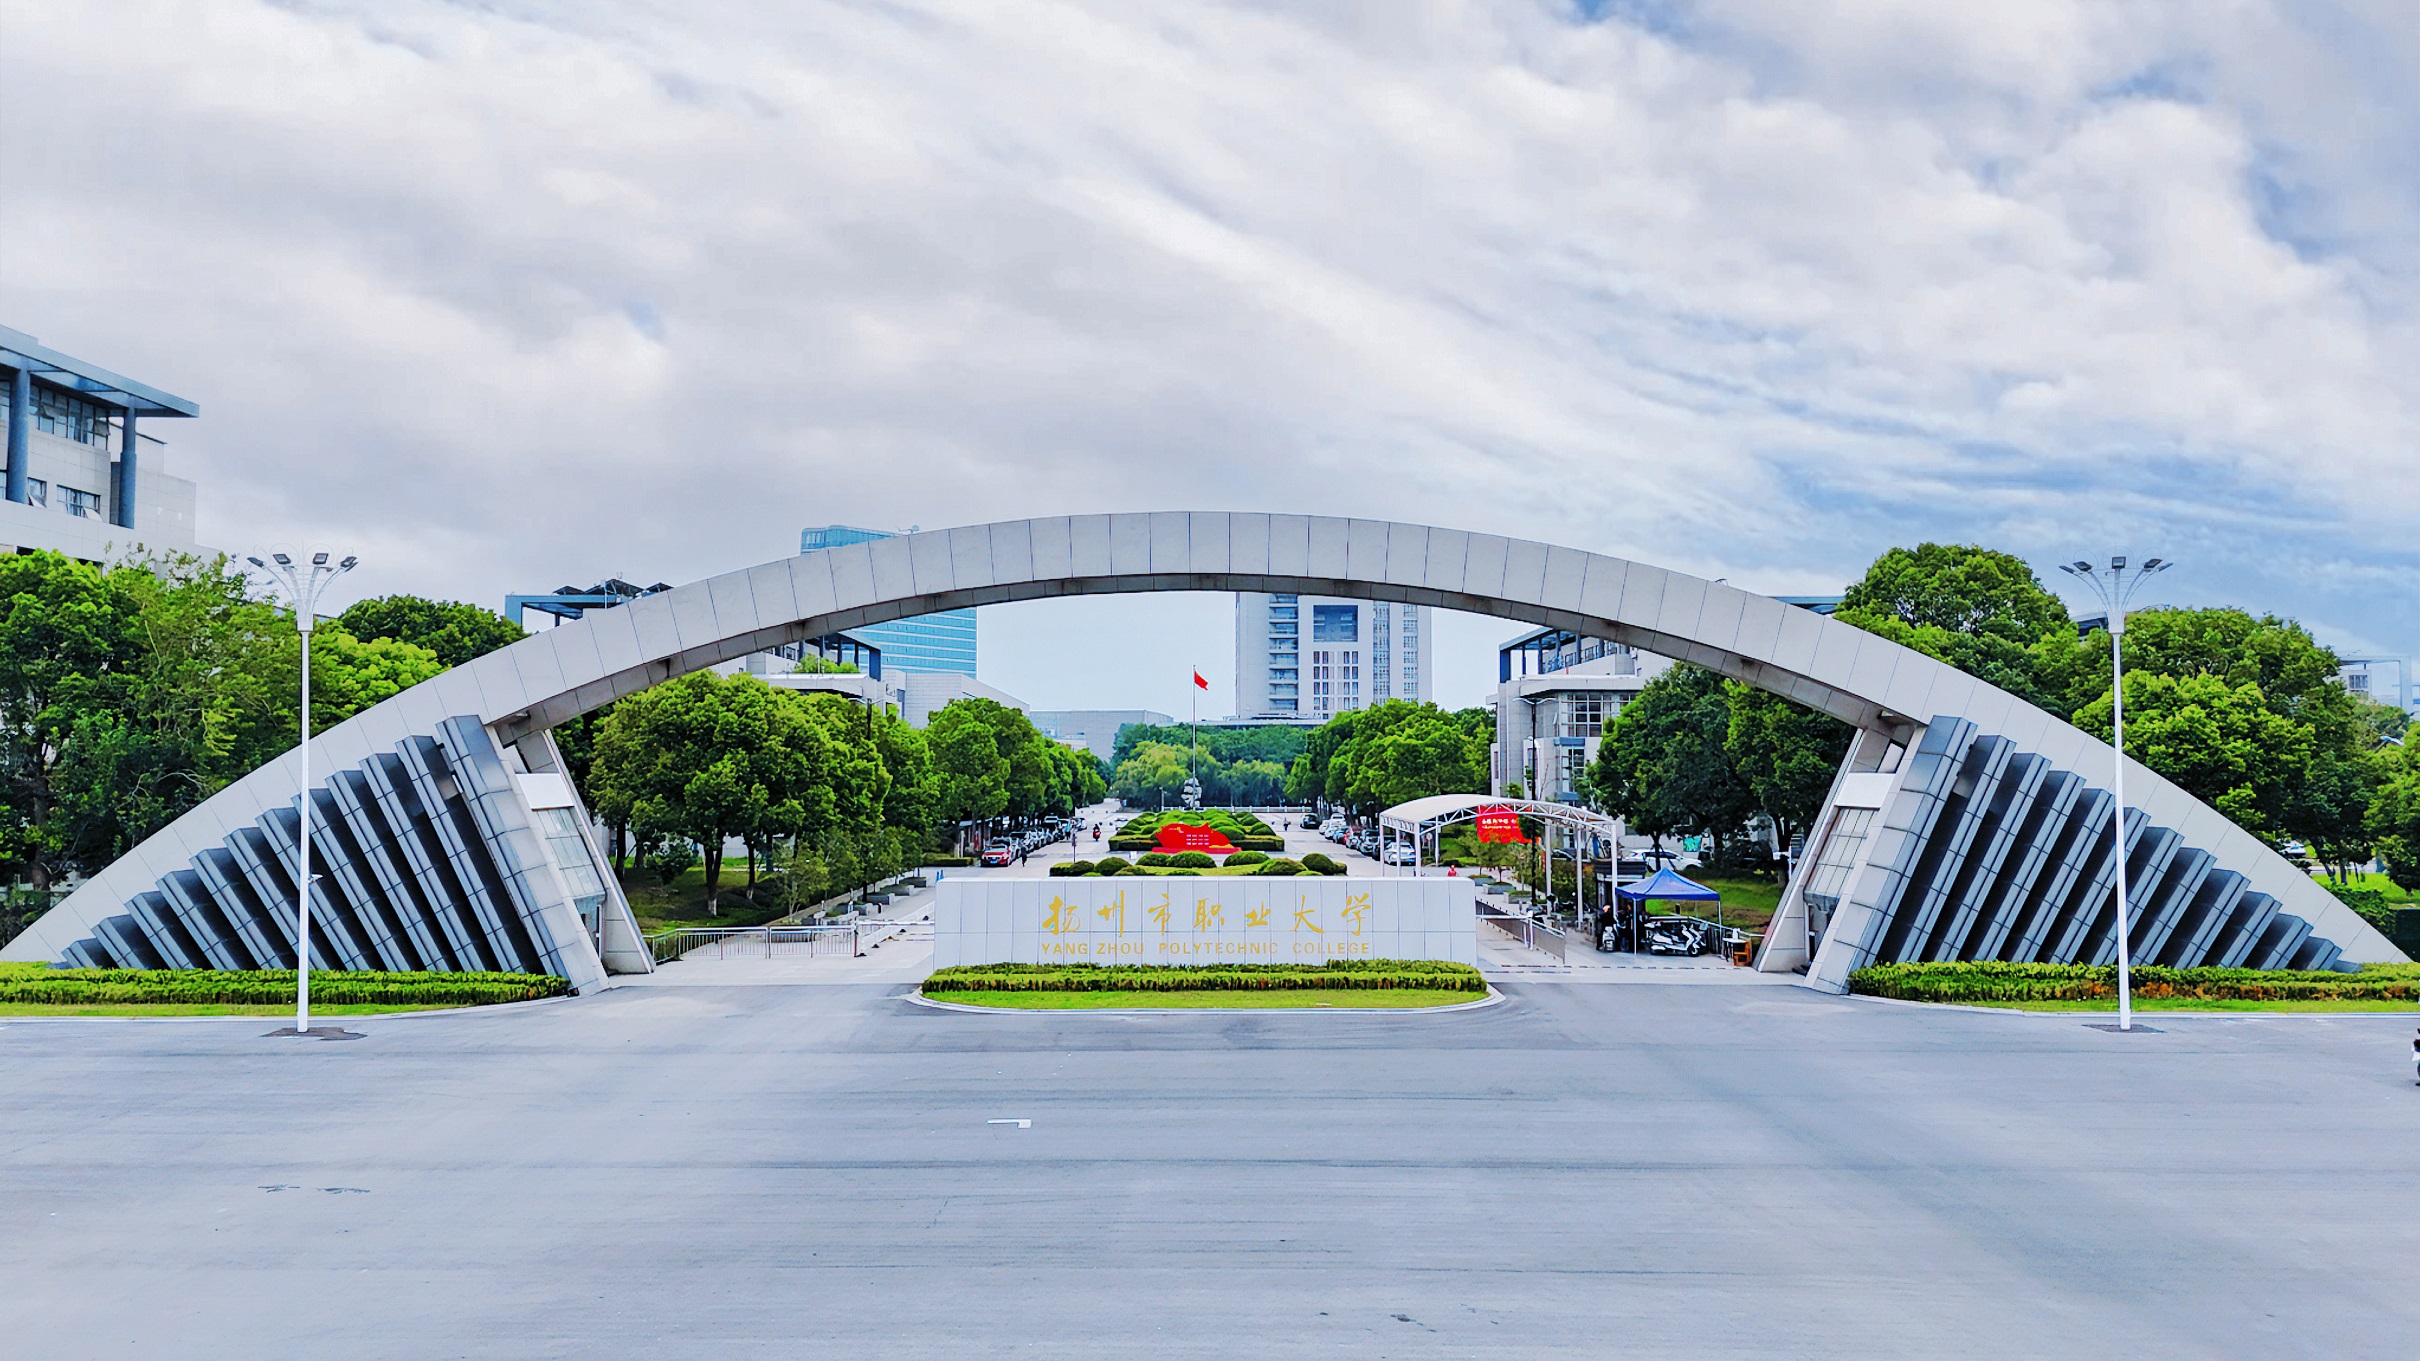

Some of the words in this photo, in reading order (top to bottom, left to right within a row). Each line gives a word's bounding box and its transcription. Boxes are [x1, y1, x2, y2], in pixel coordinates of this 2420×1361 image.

[1042, 890, 1372, 938] 扬州市职业大学
[1041, 942, 1088, 955] YANG
[1096, 942, 1144, 955] ZHOU
[1158, 942, 1279, 955] POLYTECHNIC
[1292, 942, 1370, 955] COLLEGE
